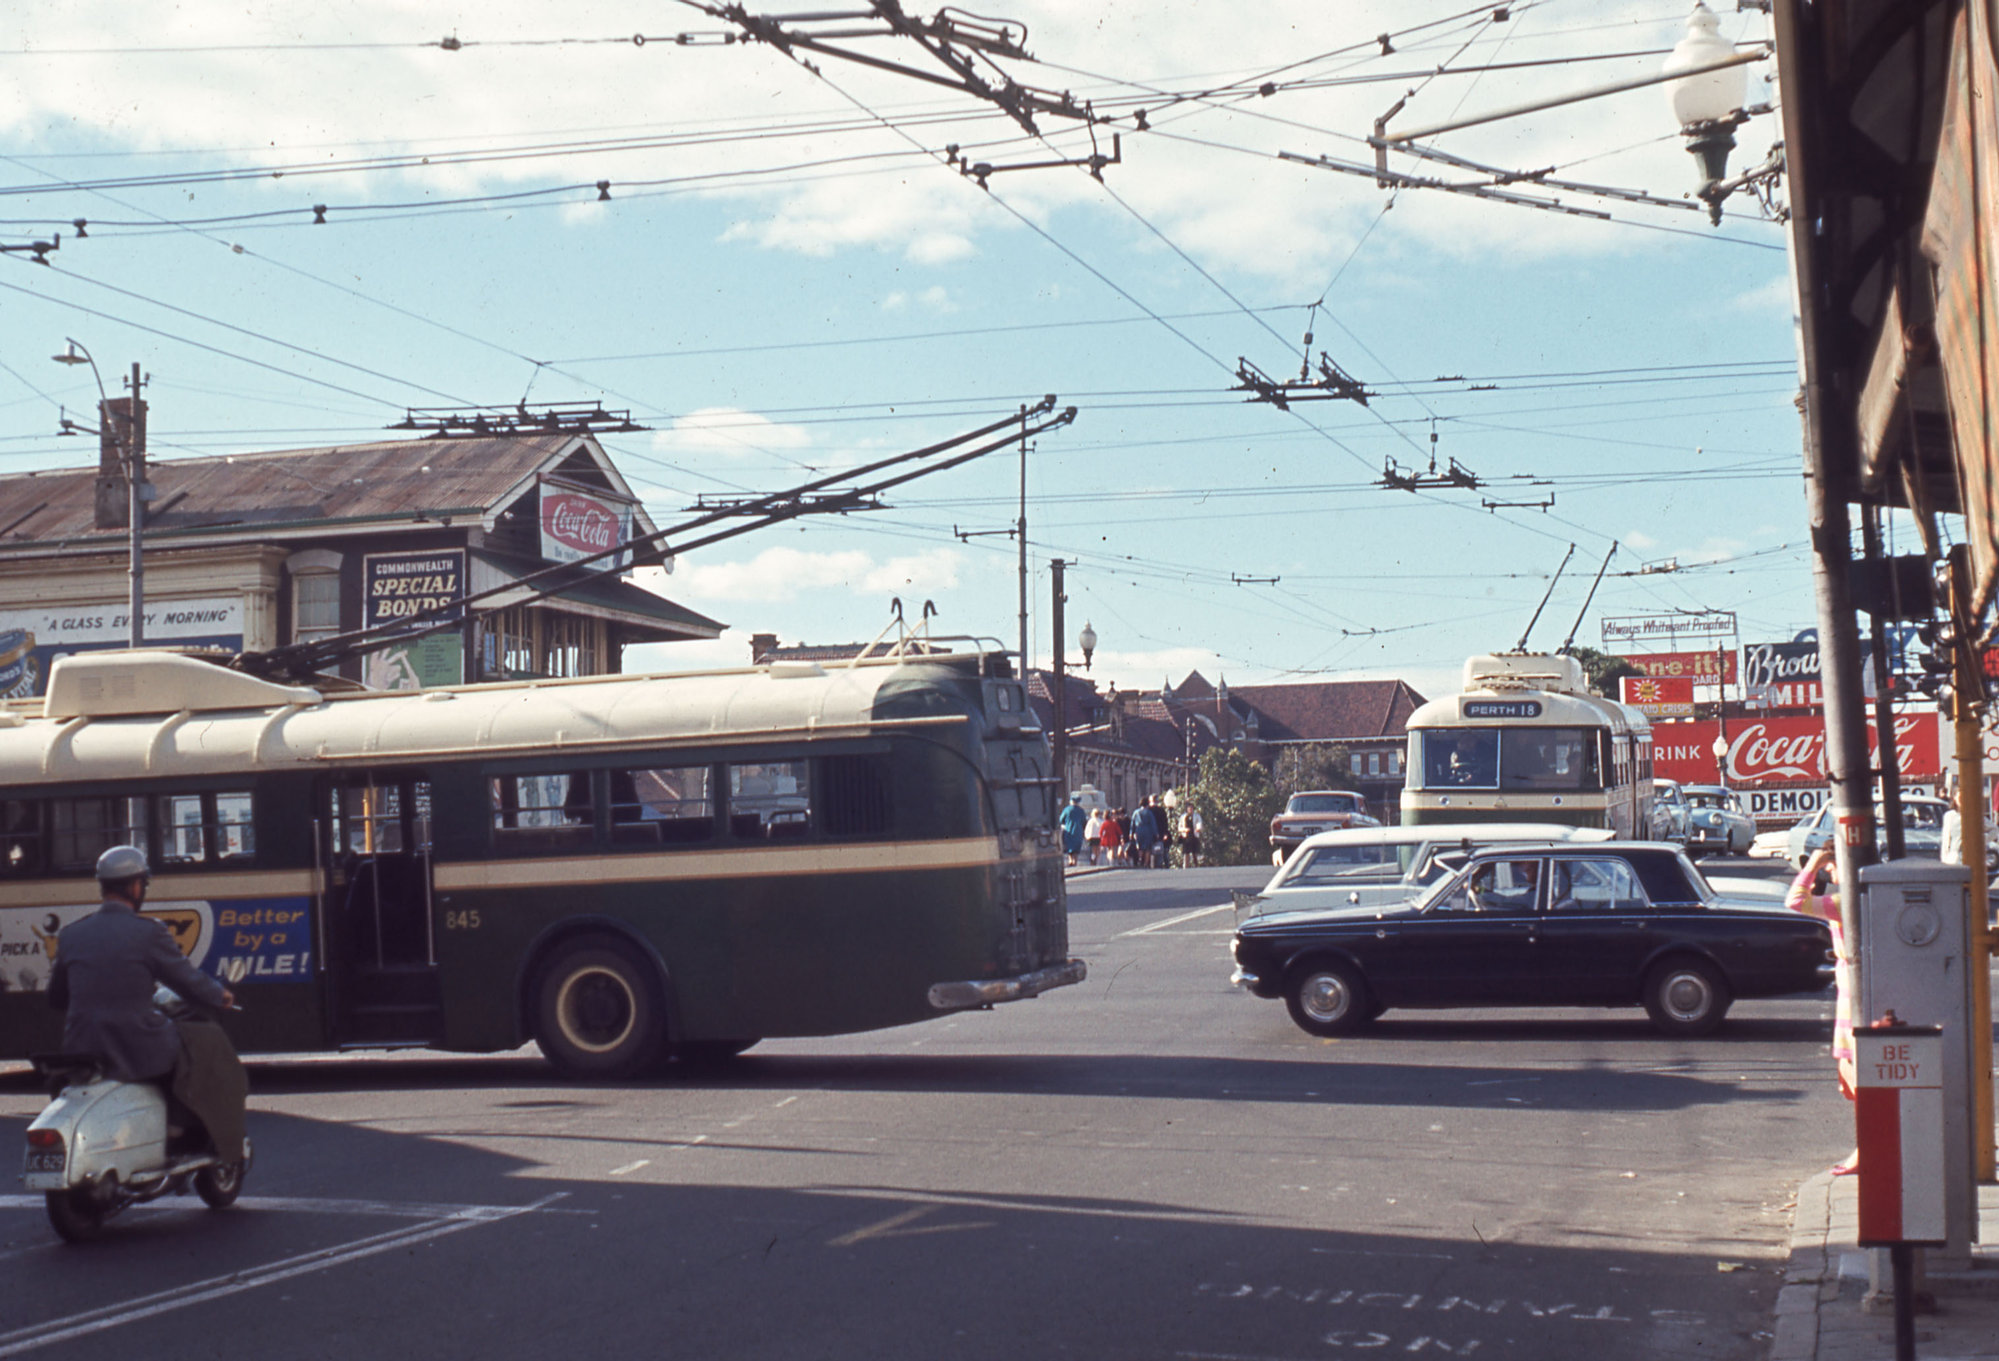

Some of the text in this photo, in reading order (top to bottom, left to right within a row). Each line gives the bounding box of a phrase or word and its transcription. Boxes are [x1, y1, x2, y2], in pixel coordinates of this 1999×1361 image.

[376, 560, 453, 575] COMMONWEALTH
[371, 574, 457, 596] SPECIAL
[375, 596, 452, 617] BONDS
[62, 616, 104, 631] GLASS
[112, 613, 156, 628] EVY
[1604, 621, 1641, 640] Always
[1692, 615, 1732, 632] Proofed
[1746, 644, 1823, 688] Brow
[1768, 683, 1824, 706] MIL
[1471, 704, 1535, 716] PERTH 18
[1661, 703, 1693, 714] CRISPS
[1654, 744, 1701, 761] RINK
[1847, 825, 1861, 843] H
[218, 908, 305, 927] Better
[445, 909, 481, 929] 845
[1, 941, 40, 957] PICK A
[233, 930, 287, 952] by a
[216, 951, 310, 977] MILE!
[1883, 1044, 1911, 1061] BE
[1875, 1063, 1920, 1080] TIDY
